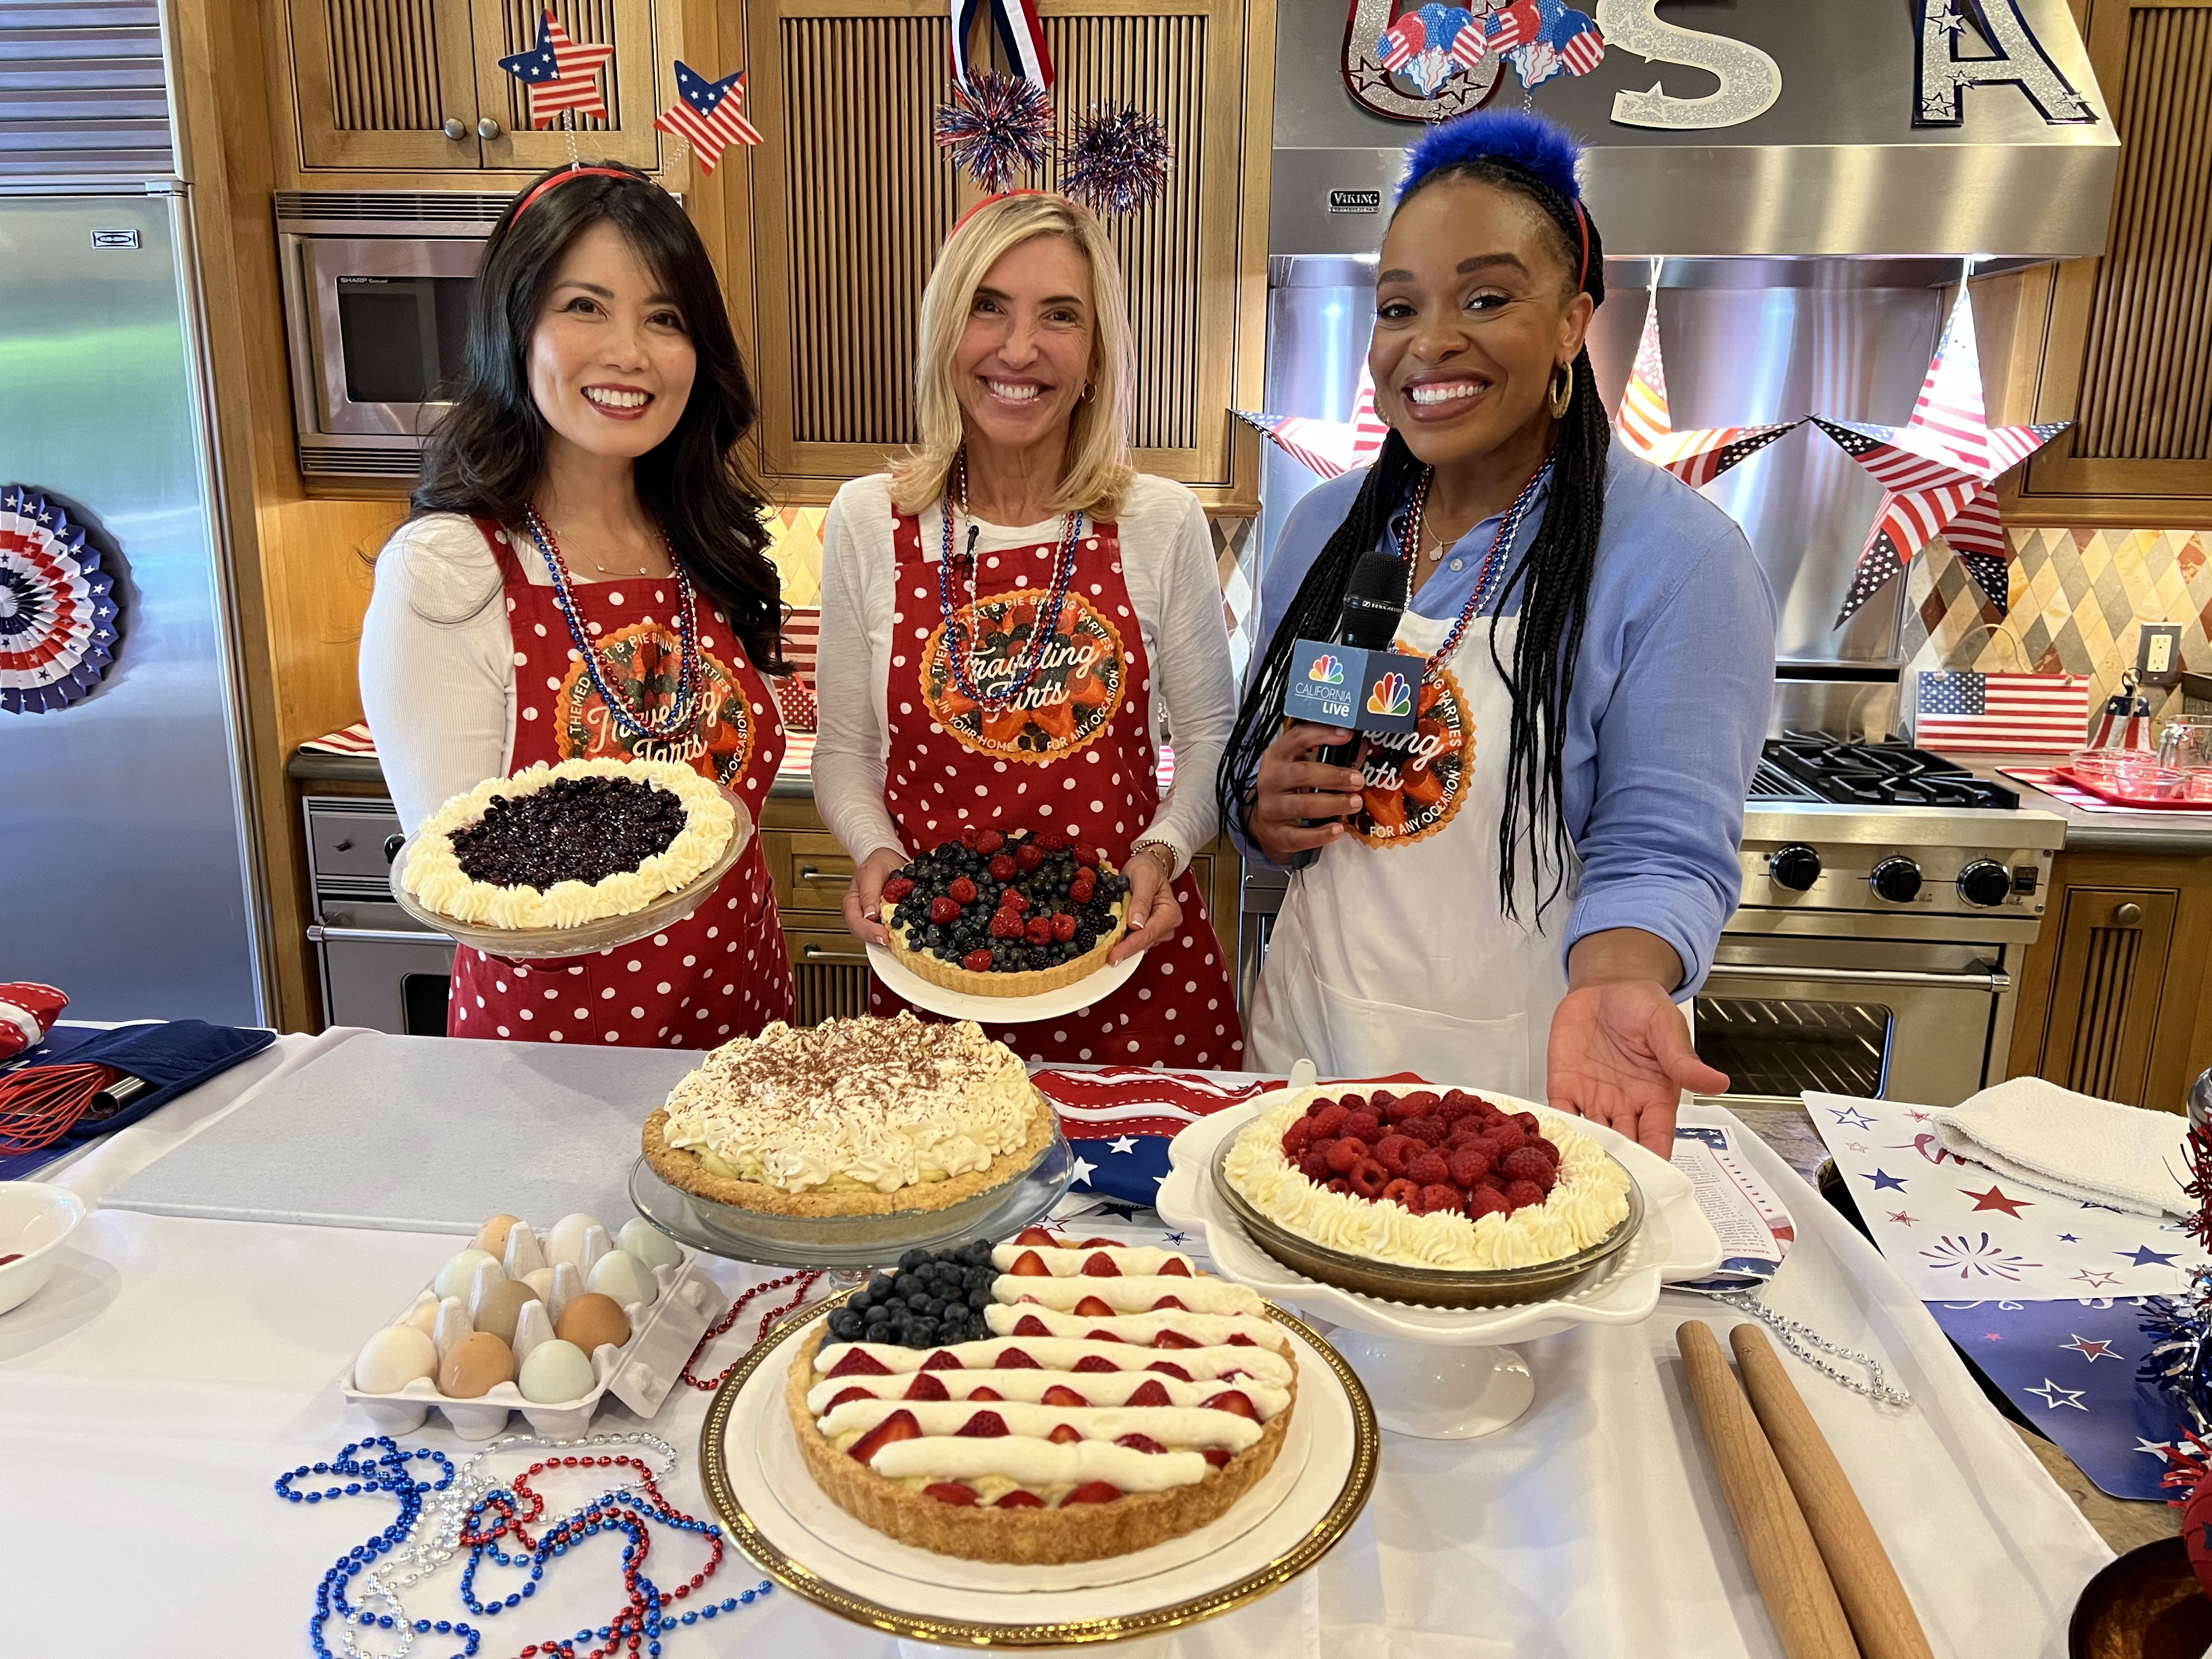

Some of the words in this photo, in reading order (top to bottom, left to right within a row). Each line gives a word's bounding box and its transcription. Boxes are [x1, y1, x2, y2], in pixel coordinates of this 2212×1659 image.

[1333, 192, 1378, 204] VIKING
[932, 634, 952, 674] THEM
[1004, 597, 1025, 609] PIE
[1077, 607, 1115, 651] PARTIES
[569, 676, 591, 734] THEMED
[628, 633, 650, 648] PIE
[701, 662, 732, 693] RTIES
[1295, 682, 1351, 702] CALIFORNIA
[938, 700, 952, 714] IN
[948, 713, 977, 740] YOUR
[978, 735, 1016, 753] HOME
[1047, 736, 1068, 751] FOR
[1070, 721, 1090, 743] ANY
[1439, 689, 1462, 747] PARTIES
[1370, 826, 1395, 838] FOR
[1399, 817, 1421, 835] ANY
